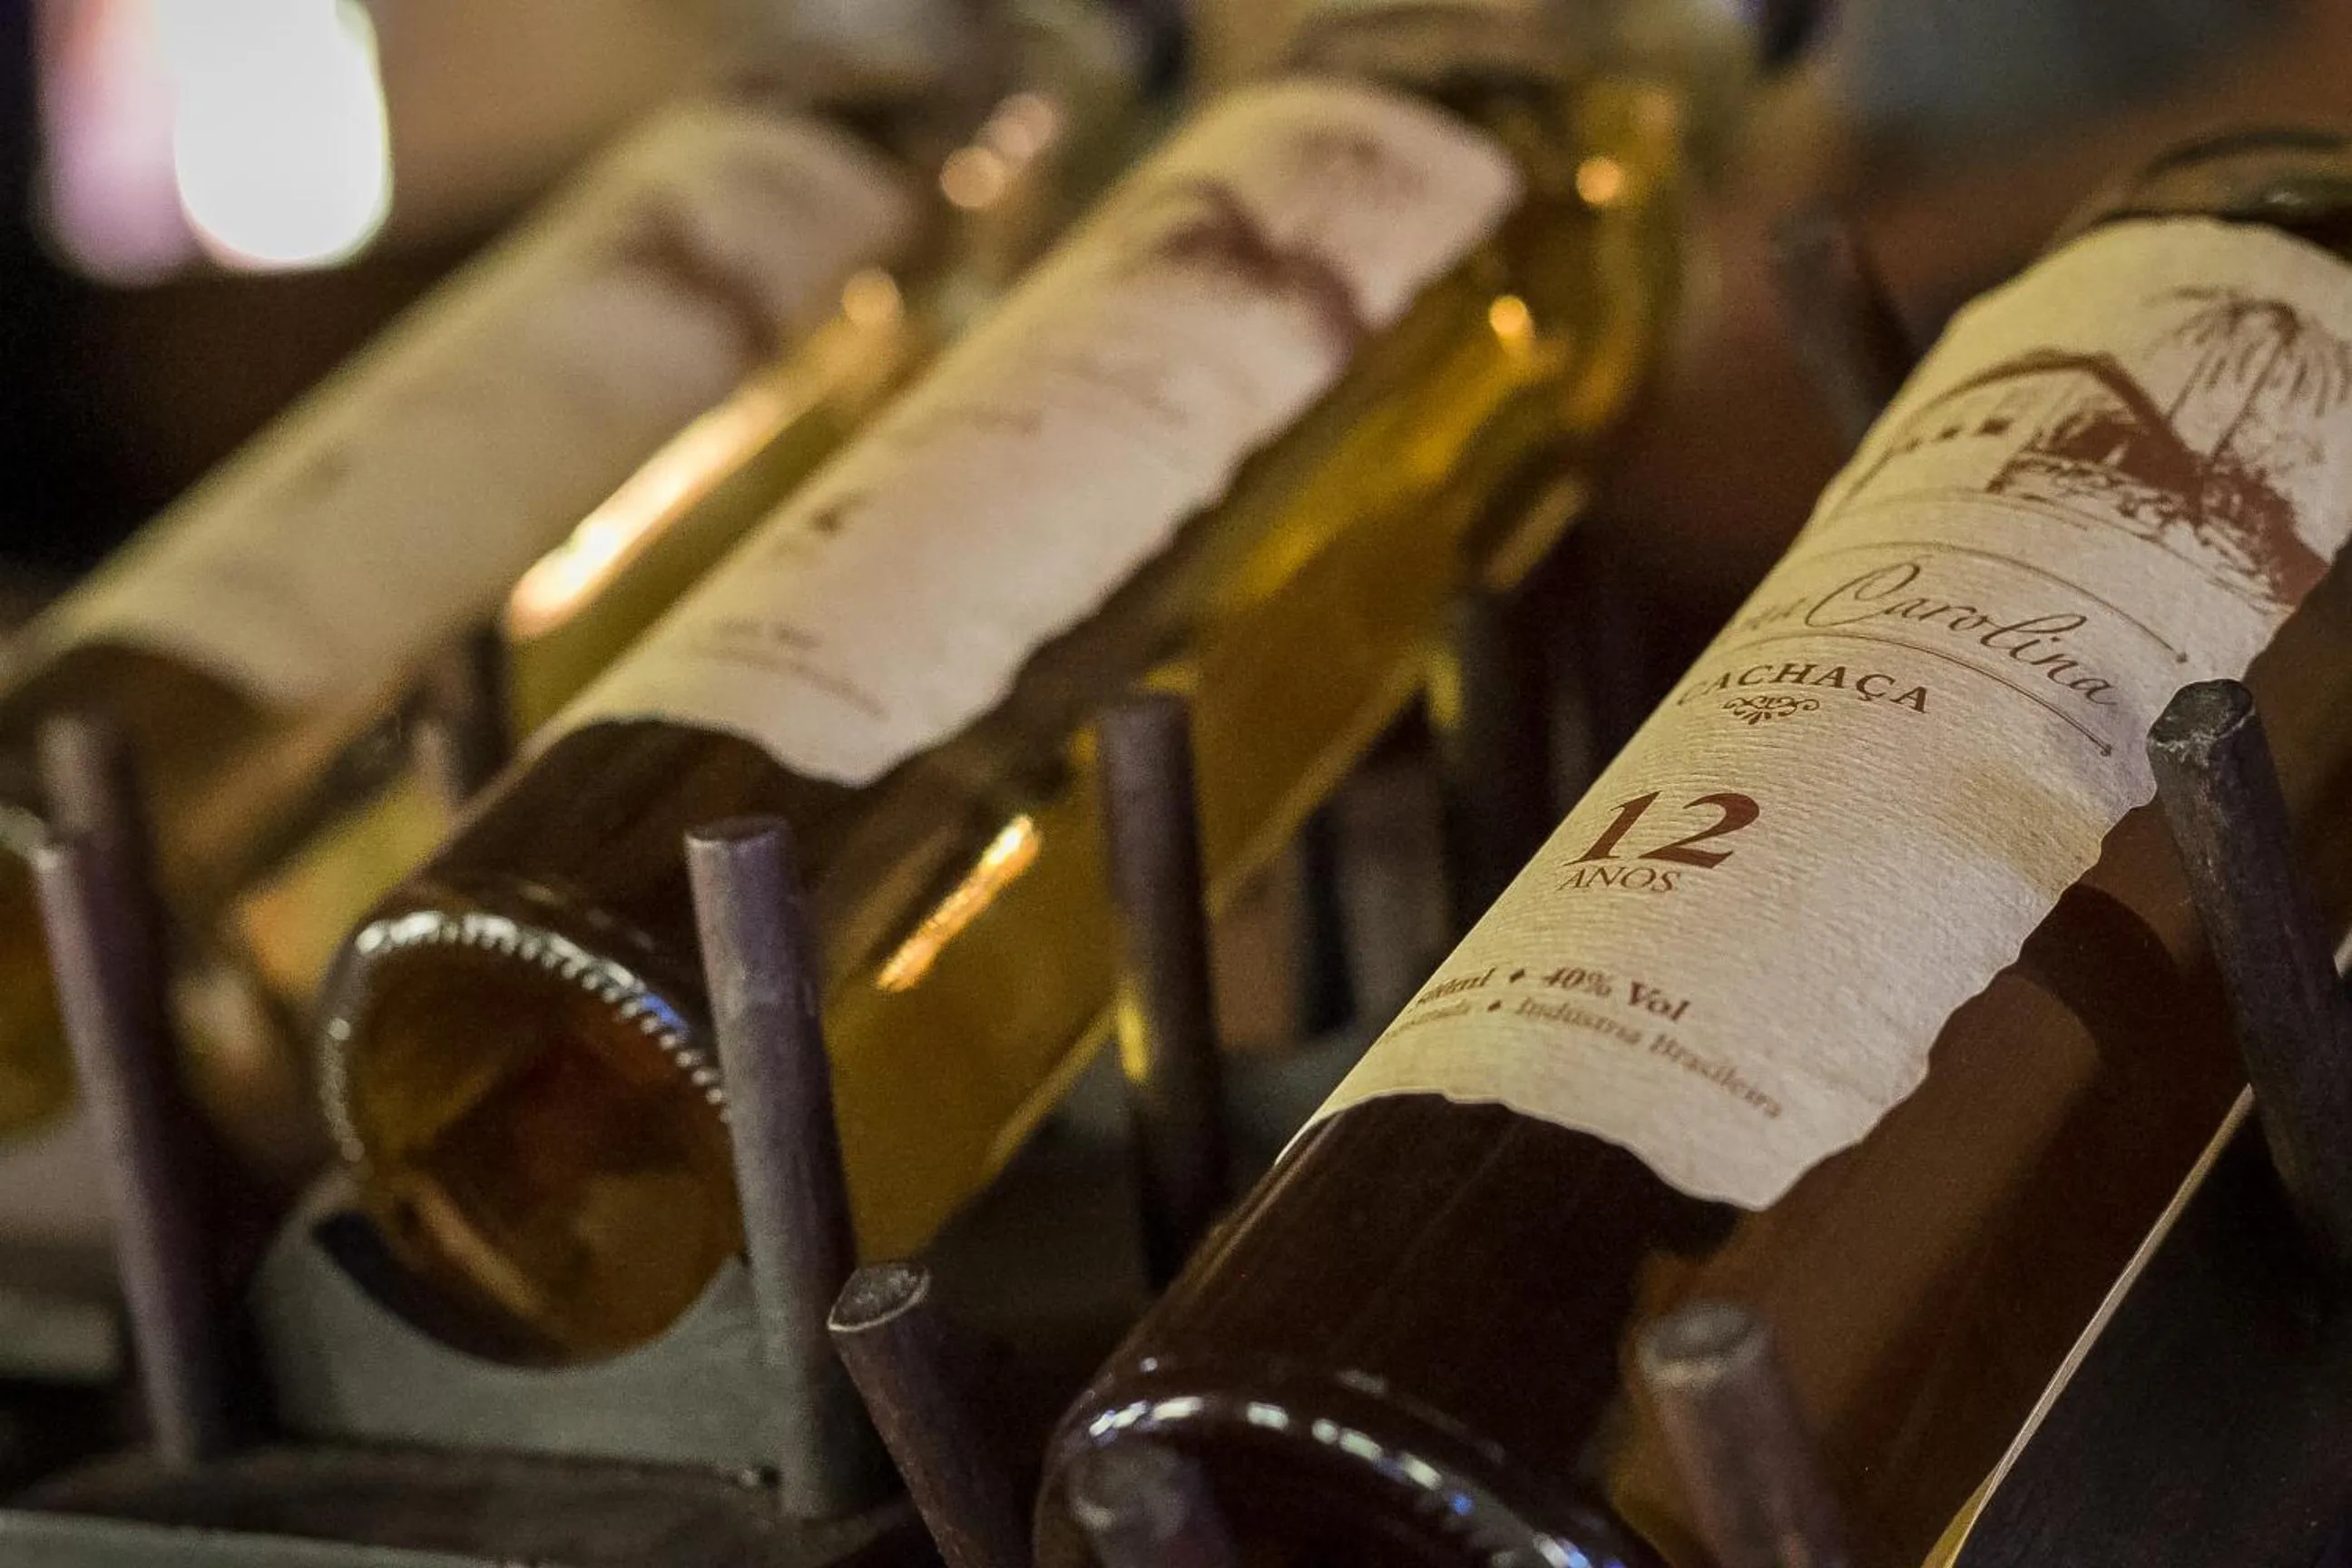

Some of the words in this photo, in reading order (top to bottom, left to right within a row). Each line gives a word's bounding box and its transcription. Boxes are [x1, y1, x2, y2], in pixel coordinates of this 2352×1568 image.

[1804, 561, 2118, 706] Carolina
[1677, 662, 1928, 714] CACHAÇA
[1563, 789, 1760, 869] 12
[1554, 866, 1681, 893] ANOS
[1542, 965, 1613, 998] 40%
[1628, 980, 1690, 1022] Vol
